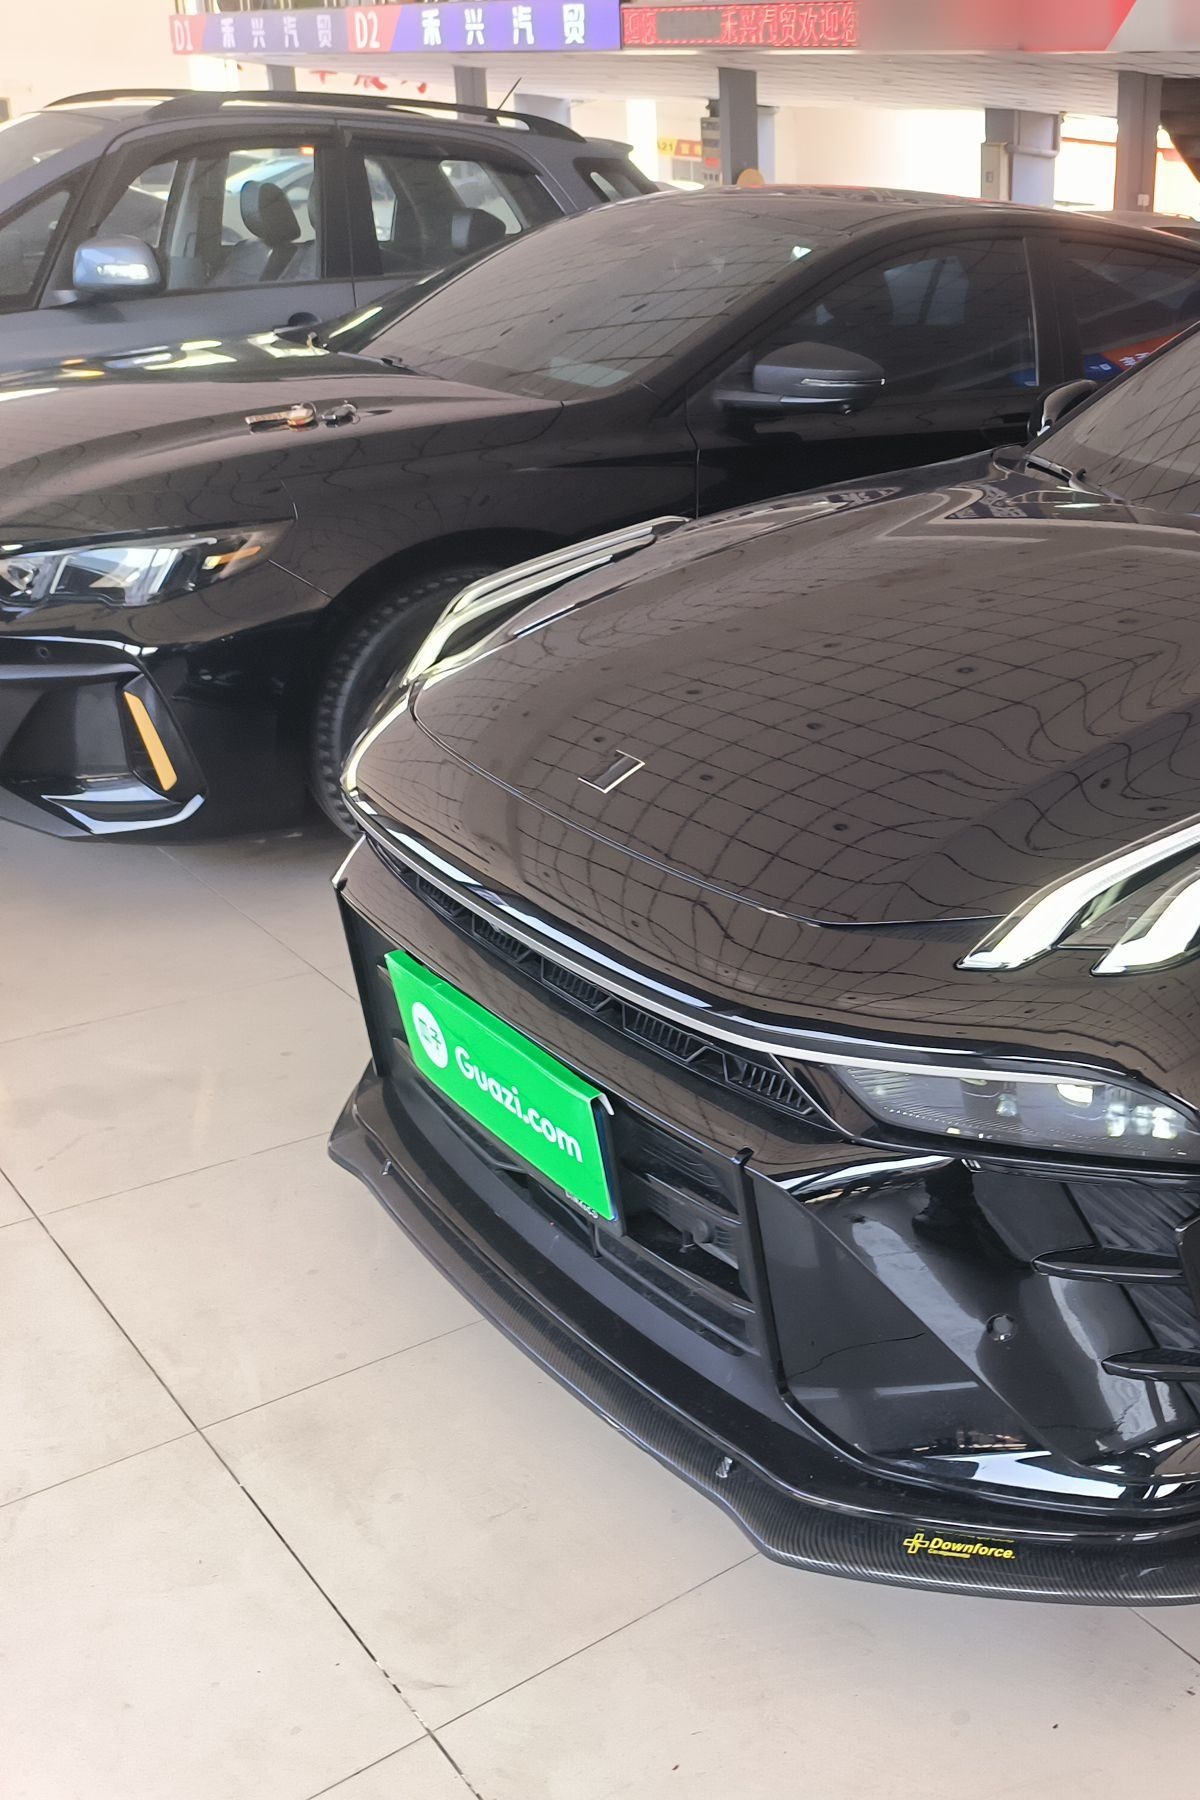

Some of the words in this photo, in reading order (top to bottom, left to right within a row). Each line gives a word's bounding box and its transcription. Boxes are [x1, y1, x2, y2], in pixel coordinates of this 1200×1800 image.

[173, 19, 194, 51] D1
[220, 14, 333, 49] 禾兴汽贸
[354, 11, 381, 49] D2
[421, 3, 585, 46] 禾兴汽贸
[455, 1045, 584, 1164] Guazi.com
